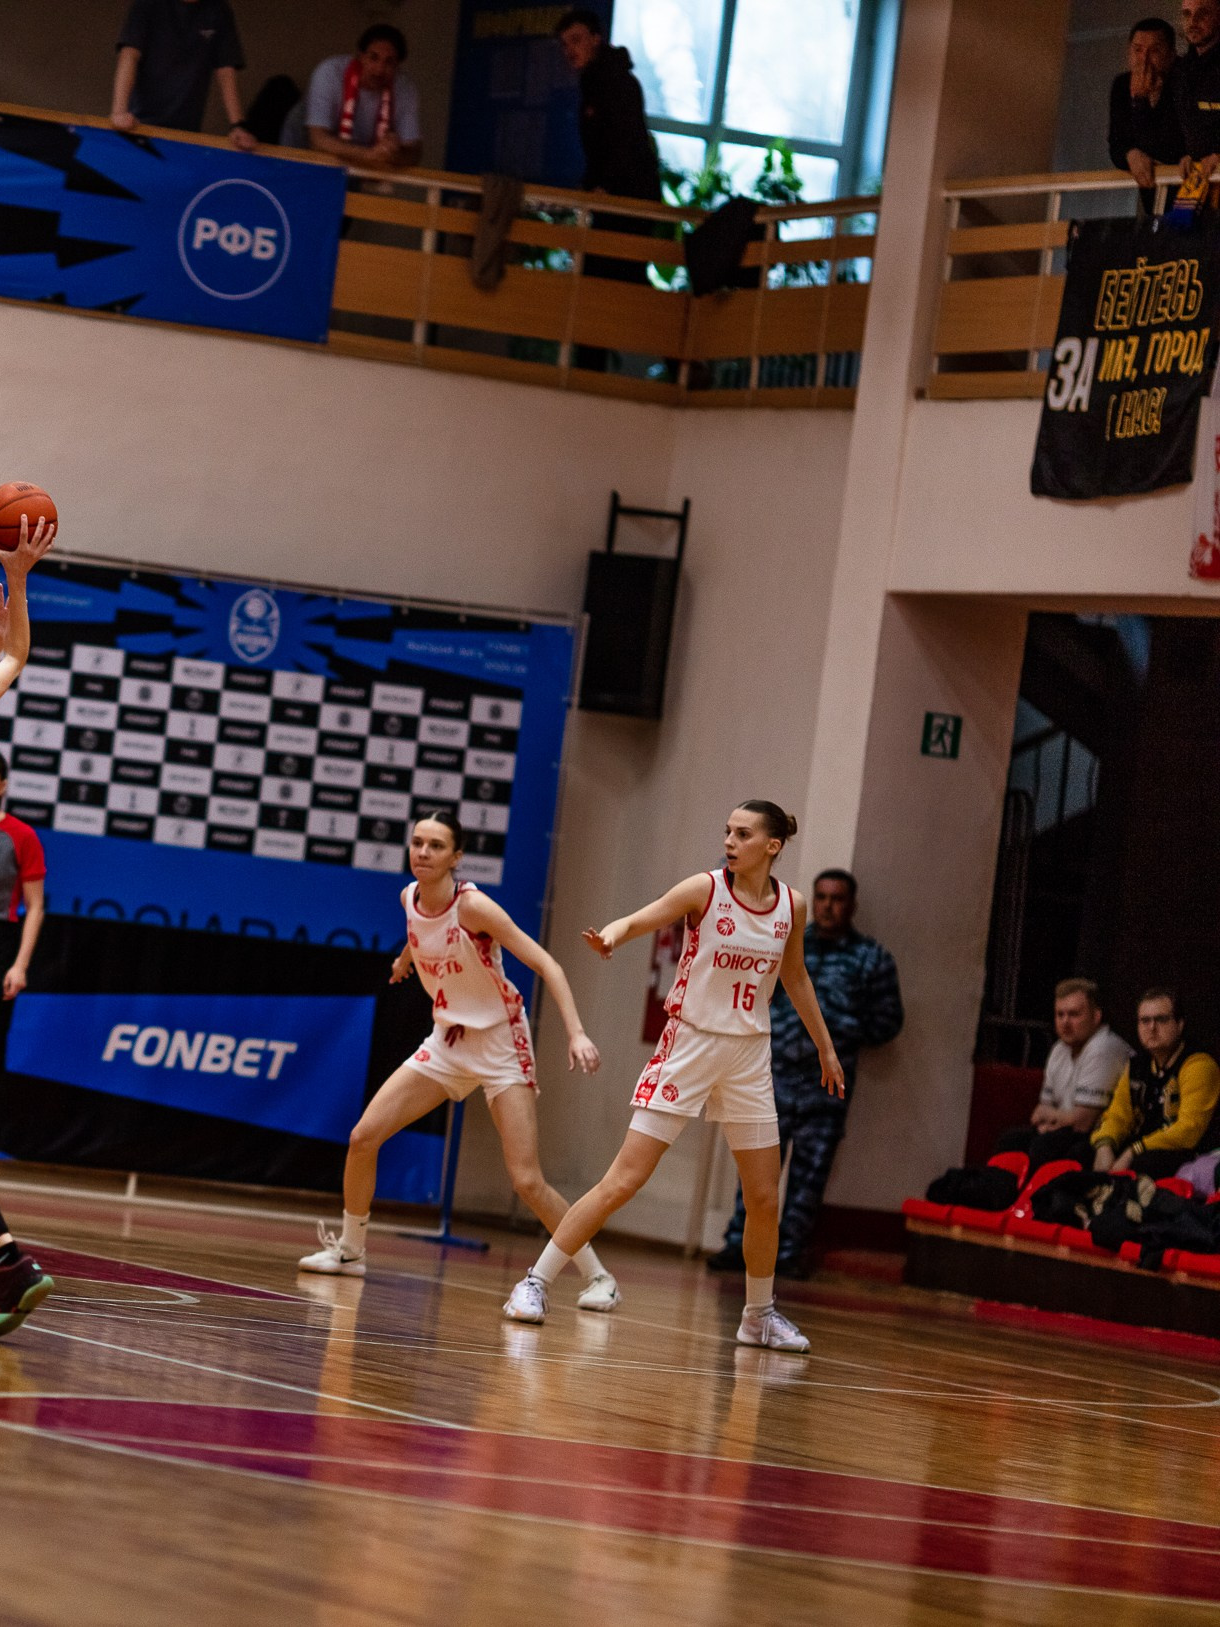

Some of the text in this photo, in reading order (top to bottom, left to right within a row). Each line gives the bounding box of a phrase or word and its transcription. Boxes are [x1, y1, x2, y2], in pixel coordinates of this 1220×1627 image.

[192, 217, 278, 261] РФБ
[1144, 327, 1211, 378] ГОРОД
[1048, 336, 1100, 413] ЗА
[774, 921, 789, 930] FON
[774, 930, 788, 940] BET
[434, 988, 448, 1010] 4
[732, 981, 758, 1012] 15
[101, 1023, 298, 1080] FONBET
